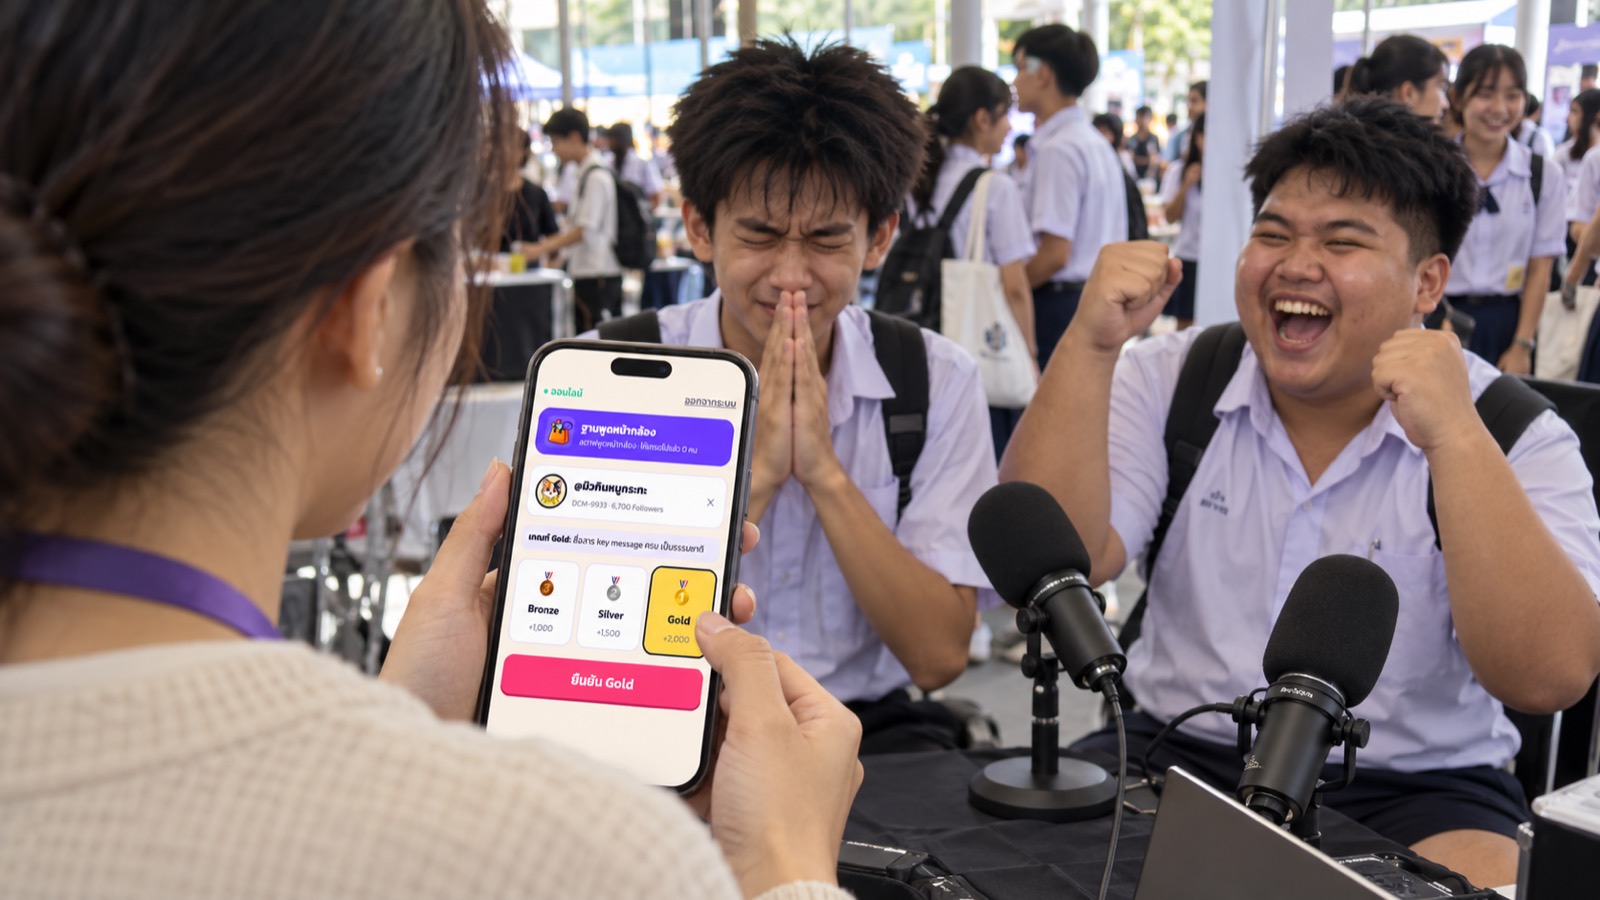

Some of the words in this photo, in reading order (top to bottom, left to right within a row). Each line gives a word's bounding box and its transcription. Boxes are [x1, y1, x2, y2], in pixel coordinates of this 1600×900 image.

[551, 387, 583, 397] ออนไลน์
[685, 397, 736, 408] ออกจากระบบ
[581, 424, 656, 437] ฐานพูดหน้ากล้อง
[682, 445, 688, 454] 0
[571, 499, 608, 509] DCM-9933
[611, 502, 631, 511] 6,700
[632, 504, 664, 513] Followers
[551, 534, 571, 543] Gold:
[597, 538, 610, 548] key
[611, 540, 643, 550] message
[543, 583, 550, 593] 3
[609, 588, 618, 598] 2
[678, 591, 685, 603] 1
[527, 604, 560, 616] Bronze
[598, 609, 625, 621] Silver
[667, 615, 691, 626] Gold
[529, 624, 553, 633] +1,000
[596, 629, 621, 638] +1,500
[663, 635, 690, 644] +2,000
[571, 672, 603, 688] ยืนยัน
[605, 677, 635, 690] Gold
